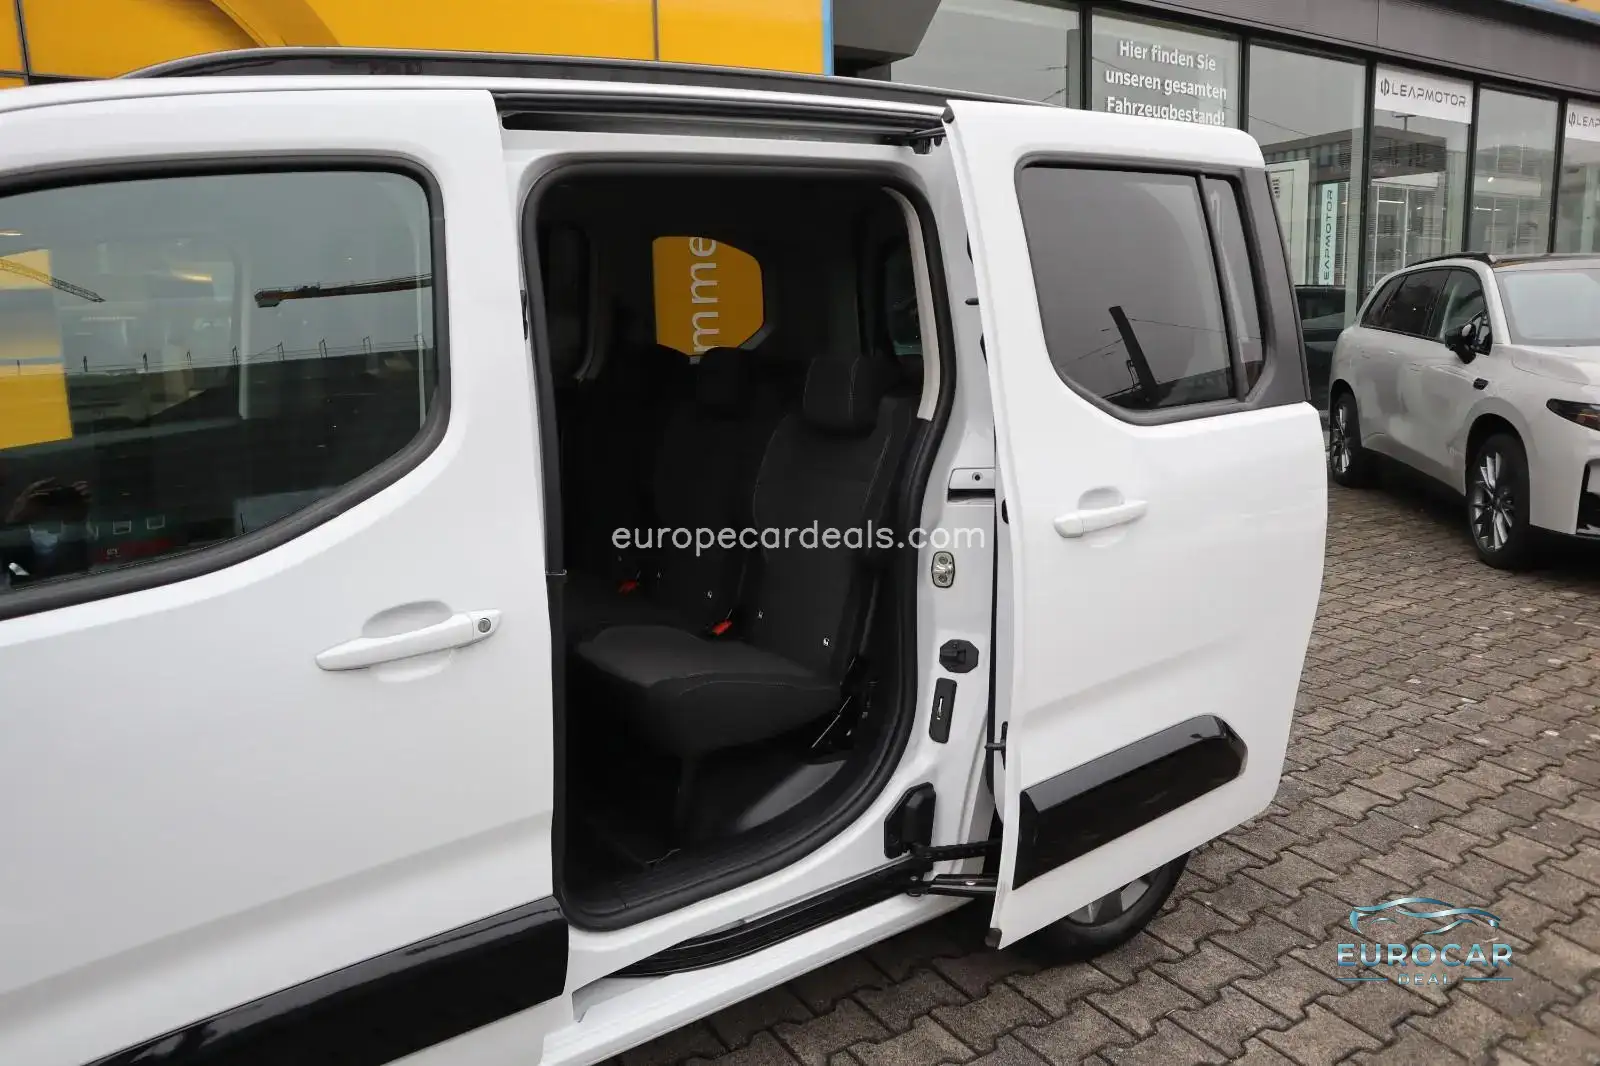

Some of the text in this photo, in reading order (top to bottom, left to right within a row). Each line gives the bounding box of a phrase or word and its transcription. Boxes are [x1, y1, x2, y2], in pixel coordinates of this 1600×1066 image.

[1119, 40, 1216, 71] Hier finden Sie
[1105, 70, 1227, 99] unseren gesamten
[1391, 80, 1467, 107] LEAPMOTOR
[1107, 96, 1225, 126] Fahrzeugbestand!
[1323, 189, 1333, 286] EAPMOTOR
